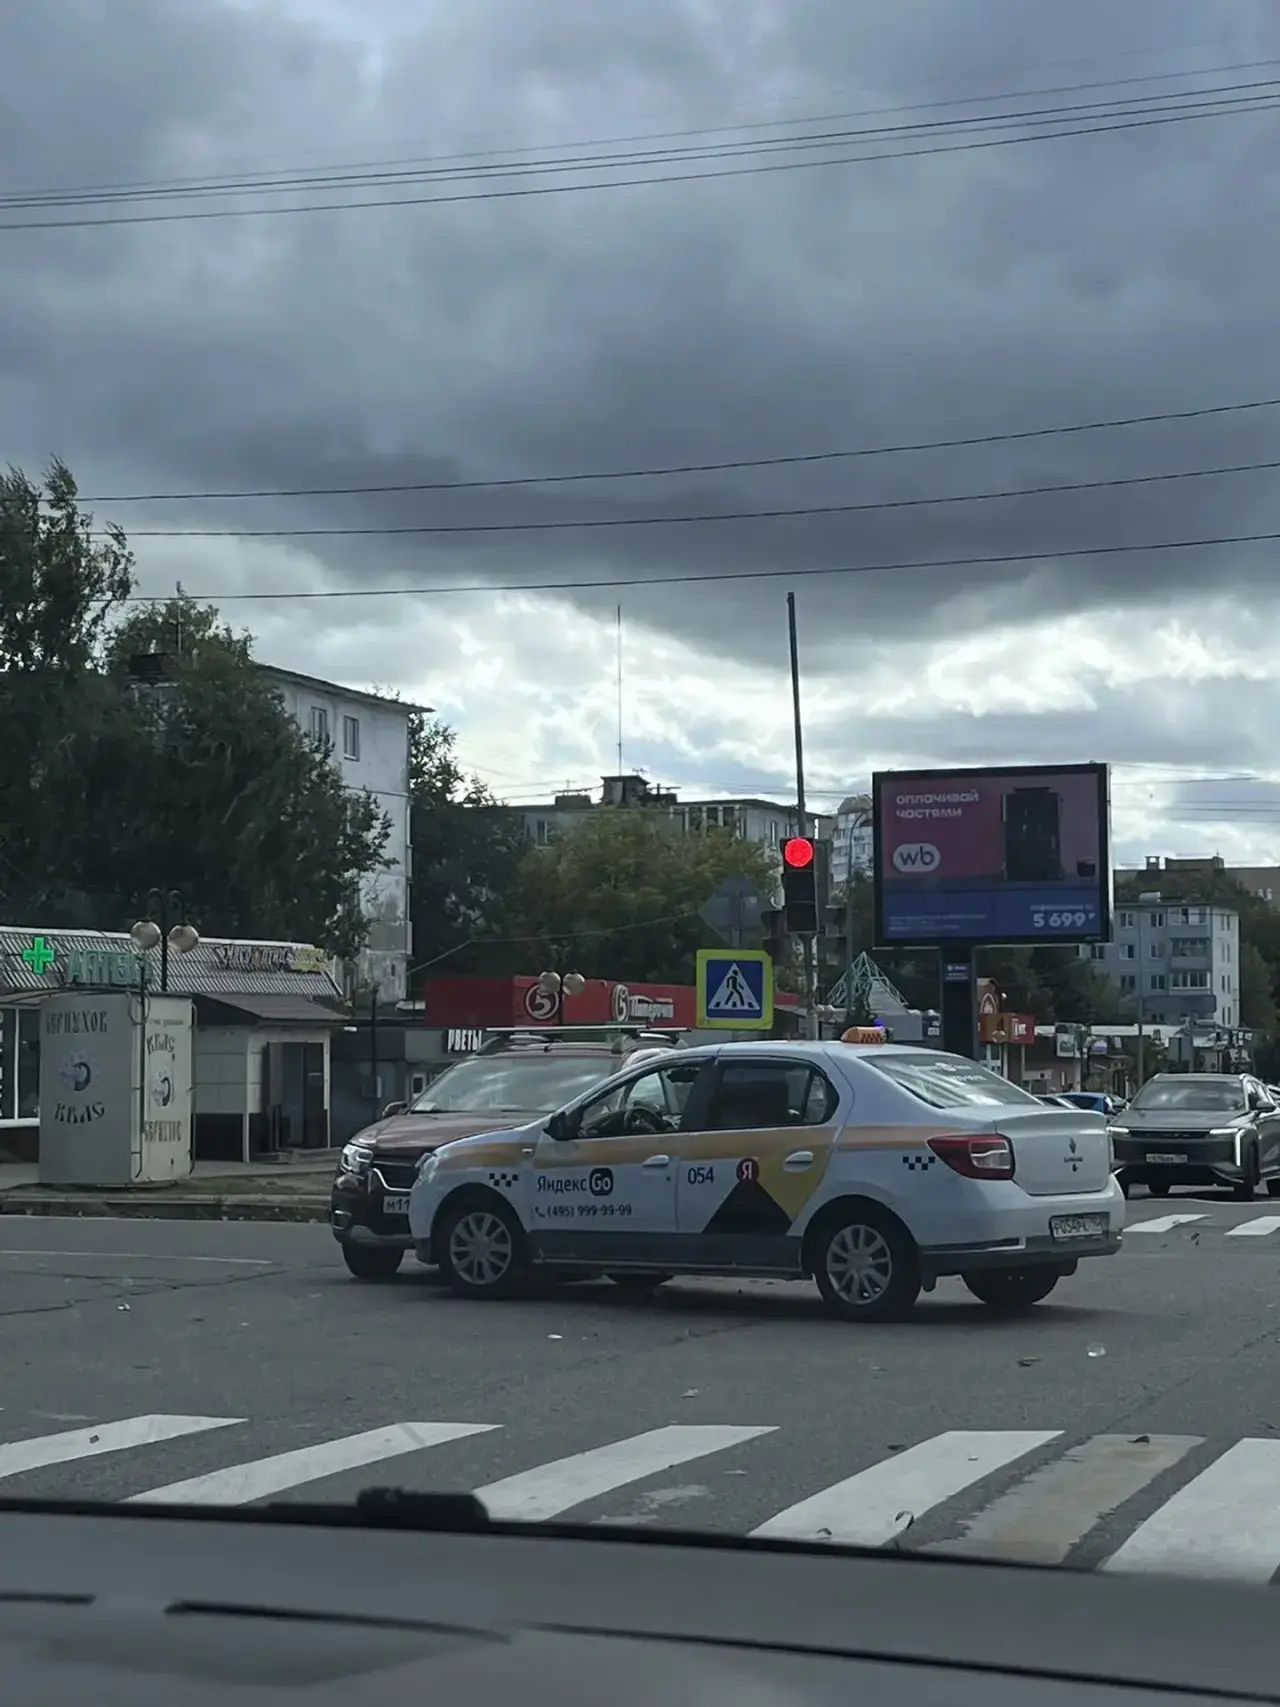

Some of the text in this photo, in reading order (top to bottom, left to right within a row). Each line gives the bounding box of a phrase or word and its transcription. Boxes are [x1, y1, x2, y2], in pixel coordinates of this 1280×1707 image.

[896, 789, 980, 805] оплачивай
[896, 807, 963, 819] частями
[900, 846, 936, 867] wb
[1033, 913, 1045, 928] 5
[687, 1166, 714, 1185] 054
[741, 1162, 753, 1180] Я
[537, 1171, 611, 1194] Яндекс Go
[547, 1203, 632, 1219] (495) 999-99-99
